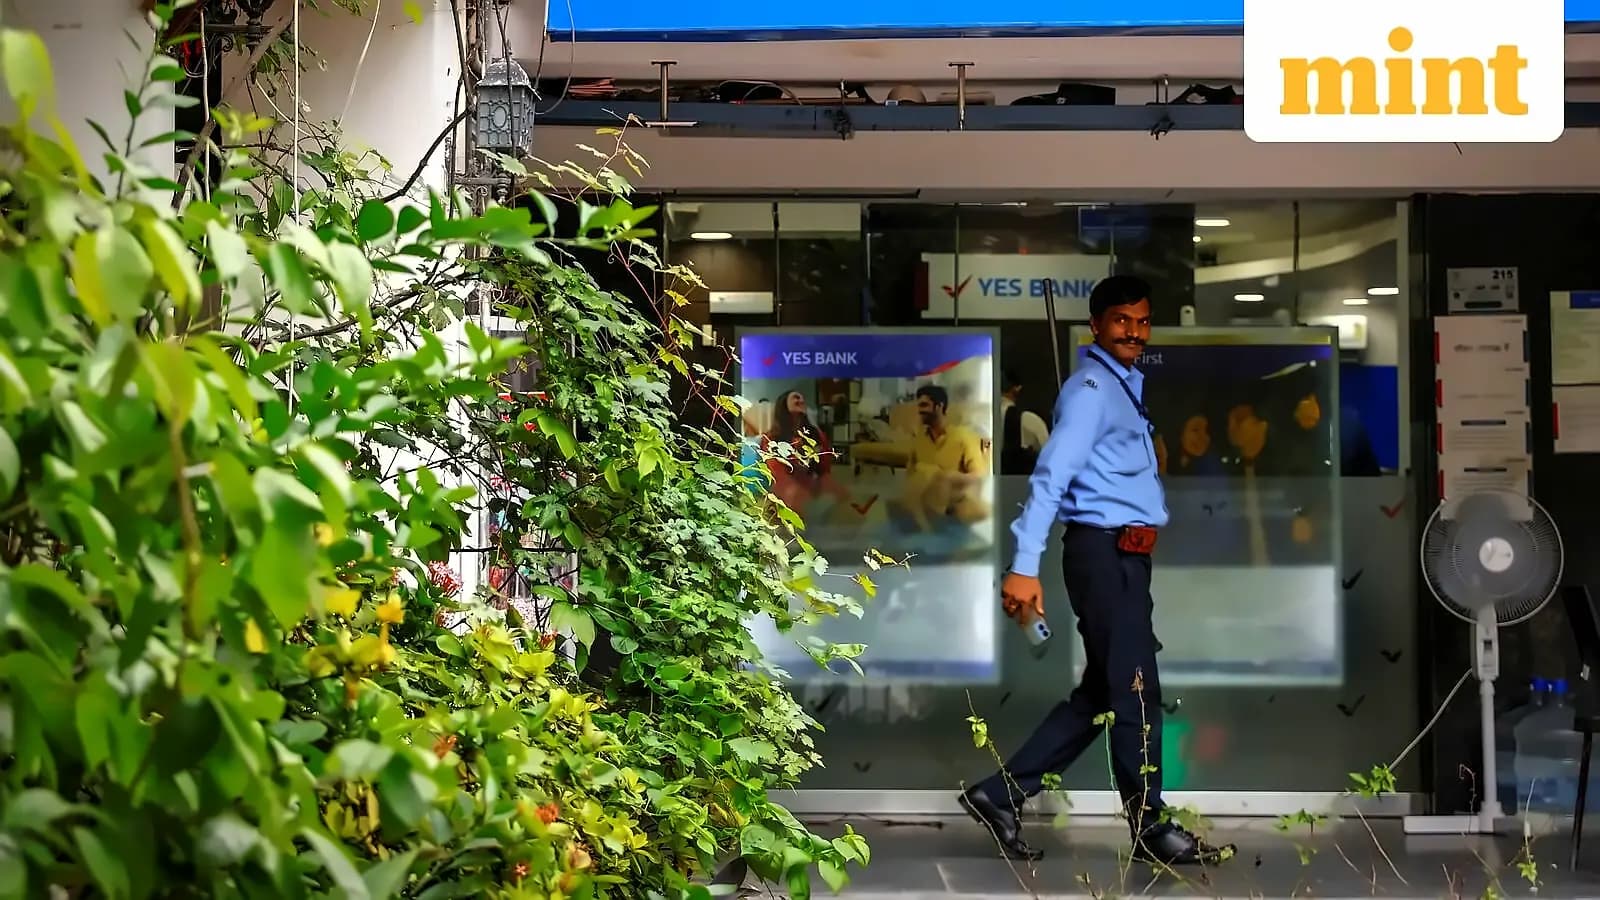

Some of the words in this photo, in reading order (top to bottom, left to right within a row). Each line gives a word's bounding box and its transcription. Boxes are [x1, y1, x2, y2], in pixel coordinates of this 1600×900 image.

[1492, 270, 1514, 279] 215
[978, 278, 1024, 297] YES
[782, 352, 811, 365] YES
[814, 352, 858, 365] BANK
